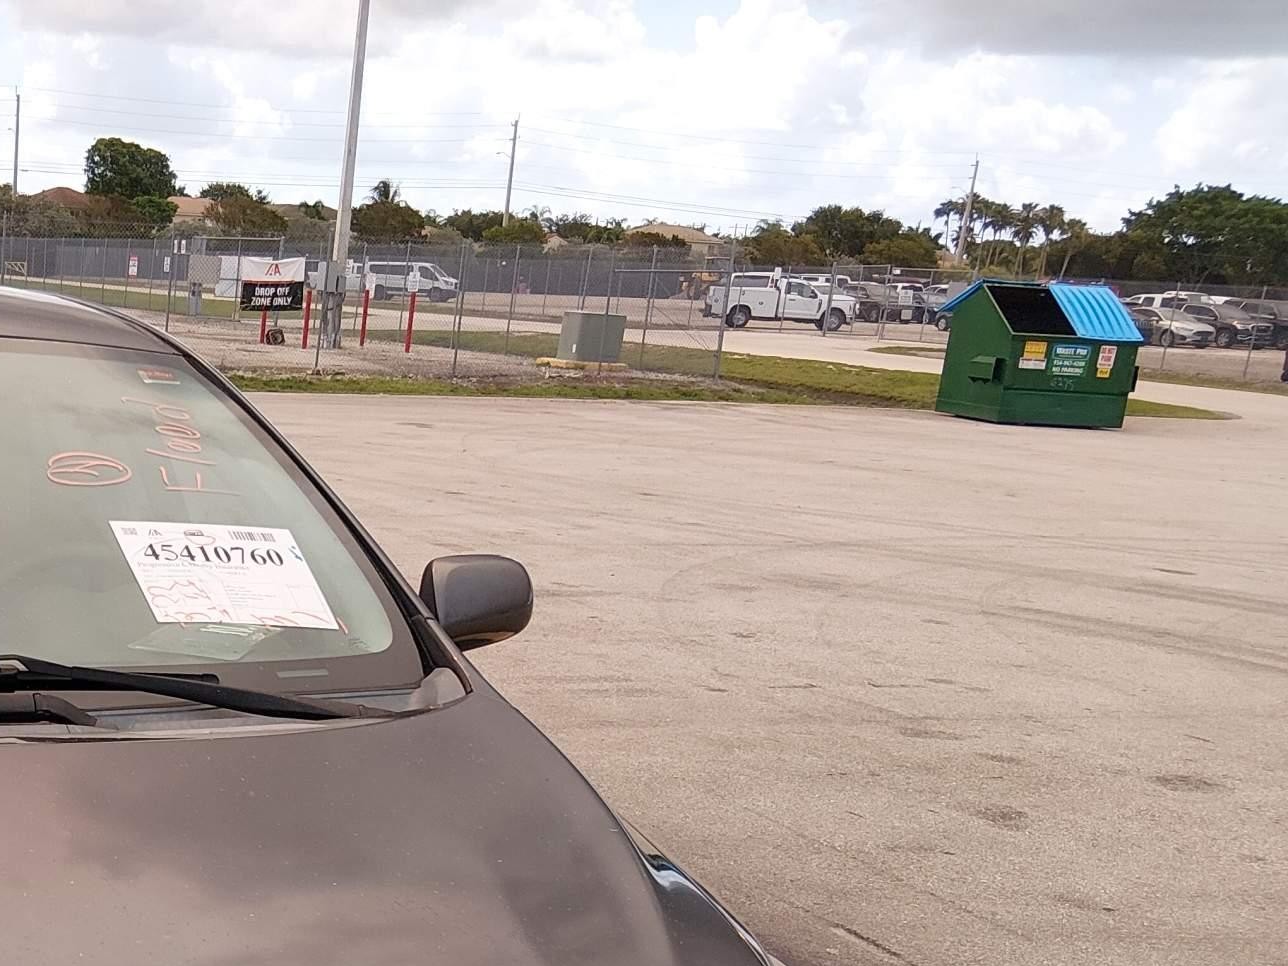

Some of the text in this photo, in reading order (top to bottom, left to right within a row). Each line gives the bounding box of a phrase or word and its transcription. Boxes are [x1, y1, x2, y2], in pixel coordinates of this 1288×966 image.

[255, 286, 290, 297] DROP OFF
[251, 296, 292, 306] ZONE ONLY
[121, 397, 241, 496] Flood
[143, 543, 284, 566] 45410760
